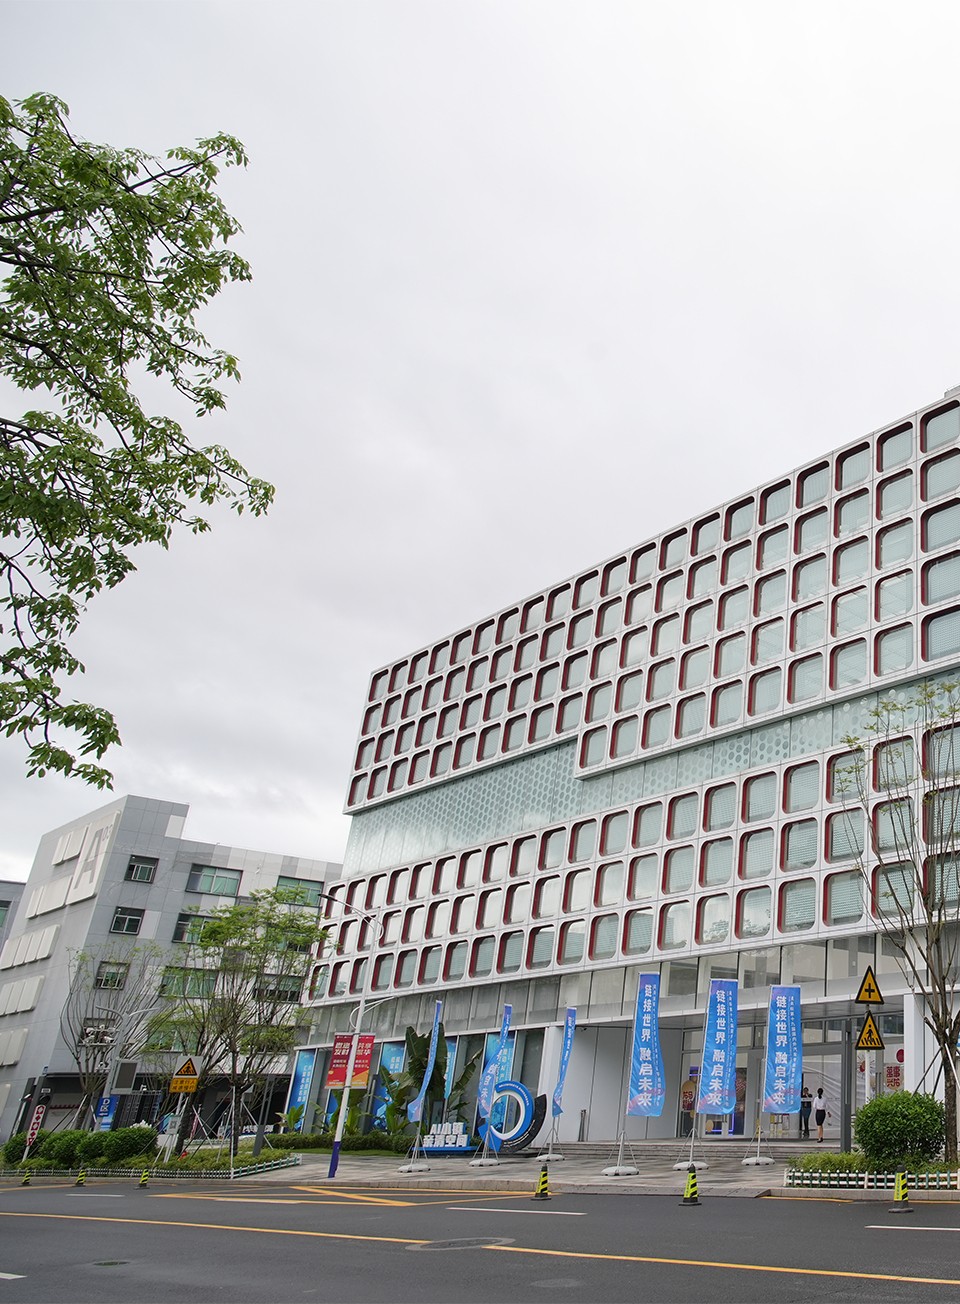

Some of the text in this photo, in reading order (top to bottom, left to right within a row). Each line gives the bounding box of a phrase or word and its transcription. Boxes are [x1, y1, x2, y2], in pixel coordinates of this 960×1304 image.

[638, 984, 653, 1107] 链接世界 融启未来
[707, 989, 727, 1107] 链接世界 融启未来
[772, 995, 788, 1105] 链接世界 融启未来
